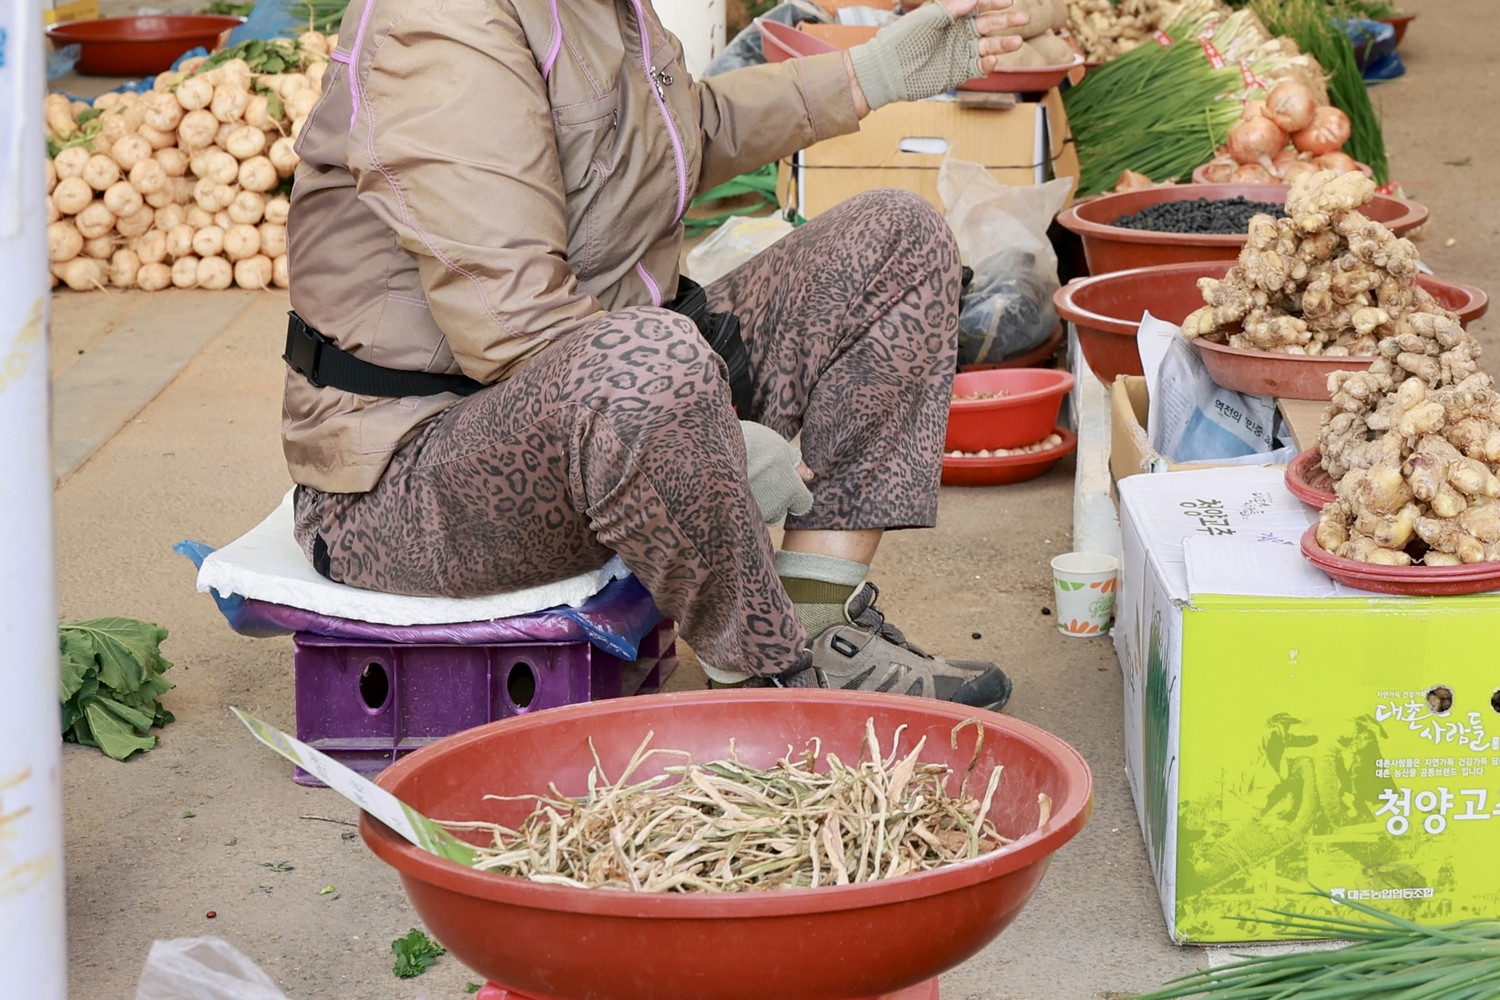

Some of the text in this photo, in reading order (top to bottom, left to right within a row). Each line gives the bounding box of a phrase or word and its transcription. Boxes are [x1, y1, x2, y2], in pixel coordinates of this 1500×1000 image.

[1215, 398, 1243, 424] 역전의
[1179, 498, 1237, 536] 청양고추
[1375, 700, 1434, 730] 대촌
[1419, 711, 1491, 752] 사람들
[1375, 758, 1421, 768] 대촌사람들은
[1424, 757, 1455, 767] 자연가득
[1458, 756, 1488, 767] 건강가득
[1375, 767, 1484, 778] 대촌 농산물 공동브랜드 입니다
